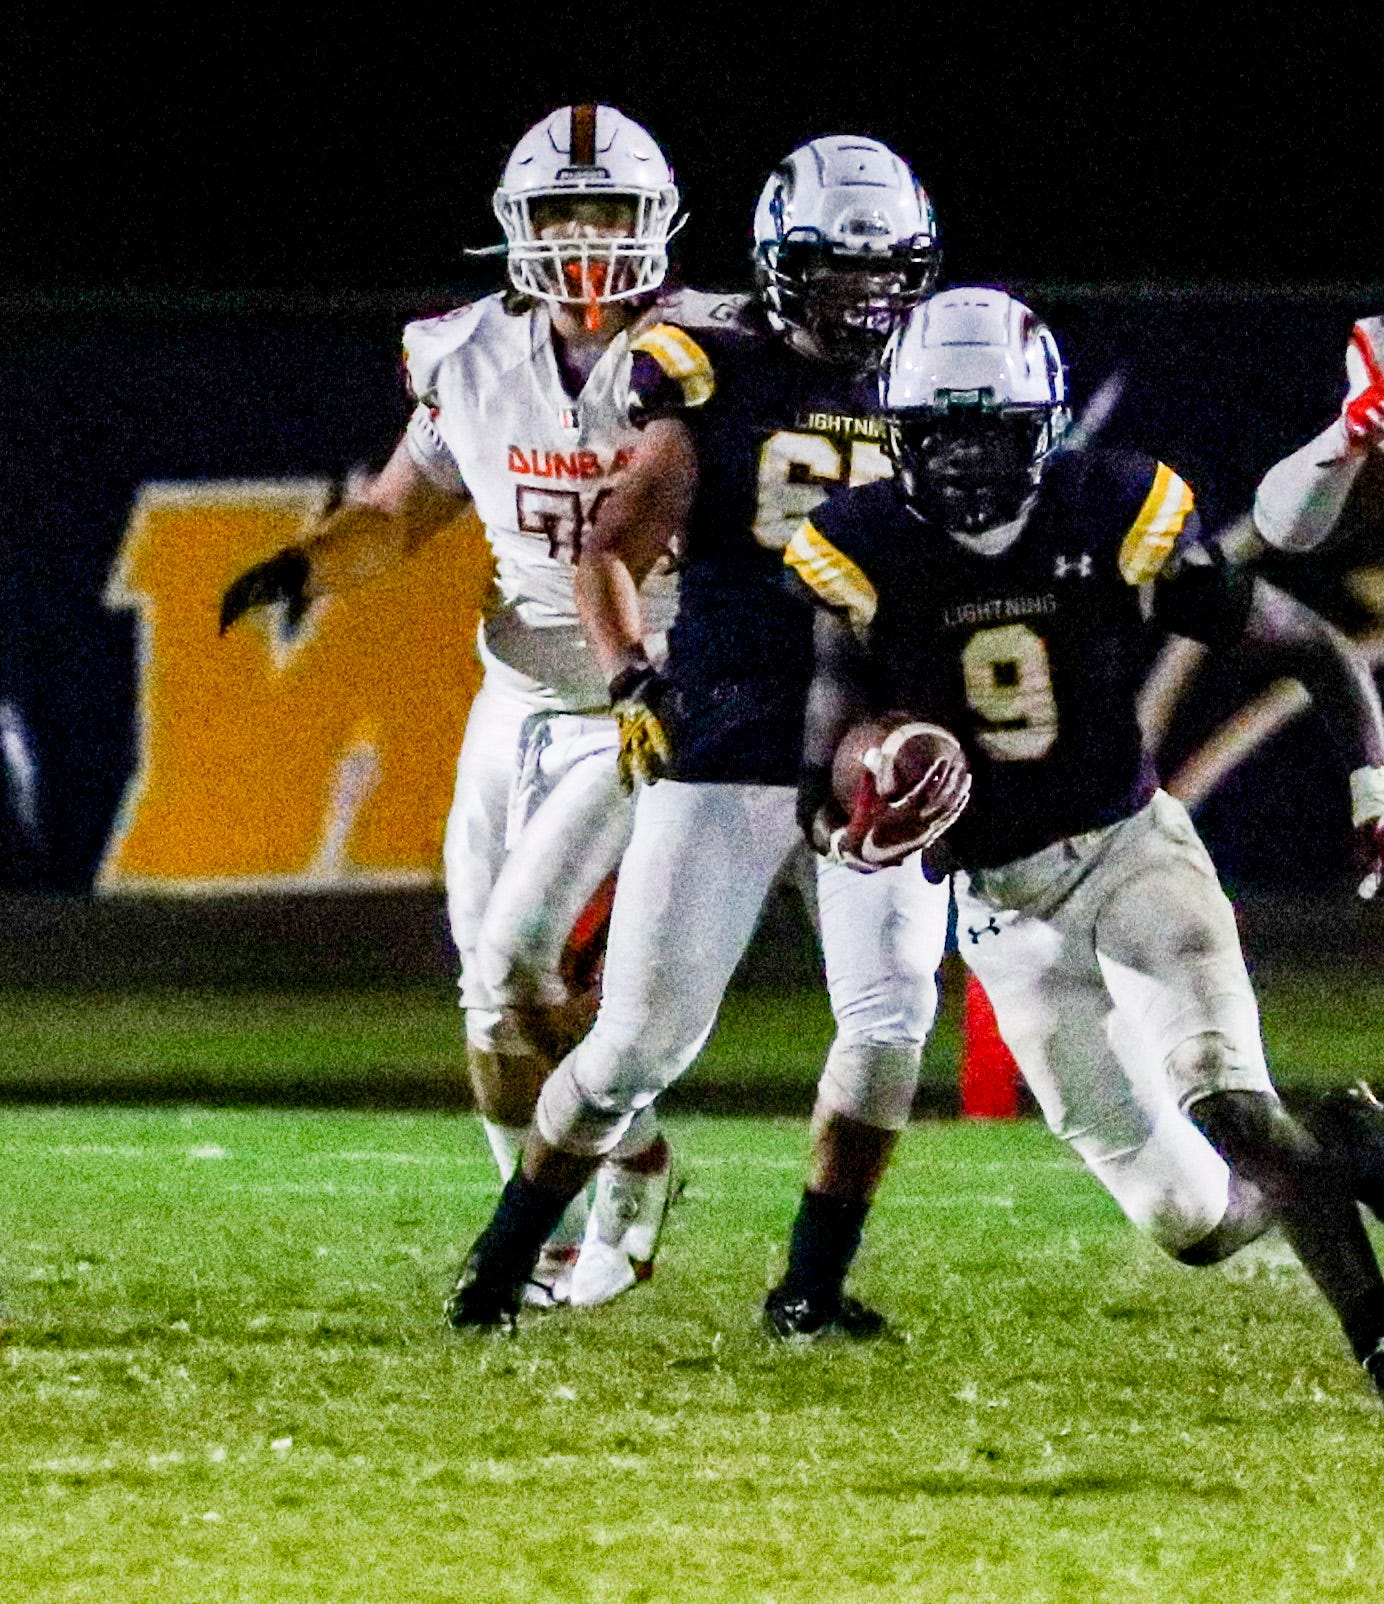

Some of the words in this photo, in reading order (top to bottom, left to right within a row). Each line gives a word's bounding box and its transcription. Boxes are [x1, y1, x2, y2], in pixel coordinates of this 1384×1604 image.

[795, 412, 888, 439] LIGHTNI
[508, 444, 636, 480] DUNBA
[516, 484, 614, 564] 7
[960, 622, 1061, 763] 9
